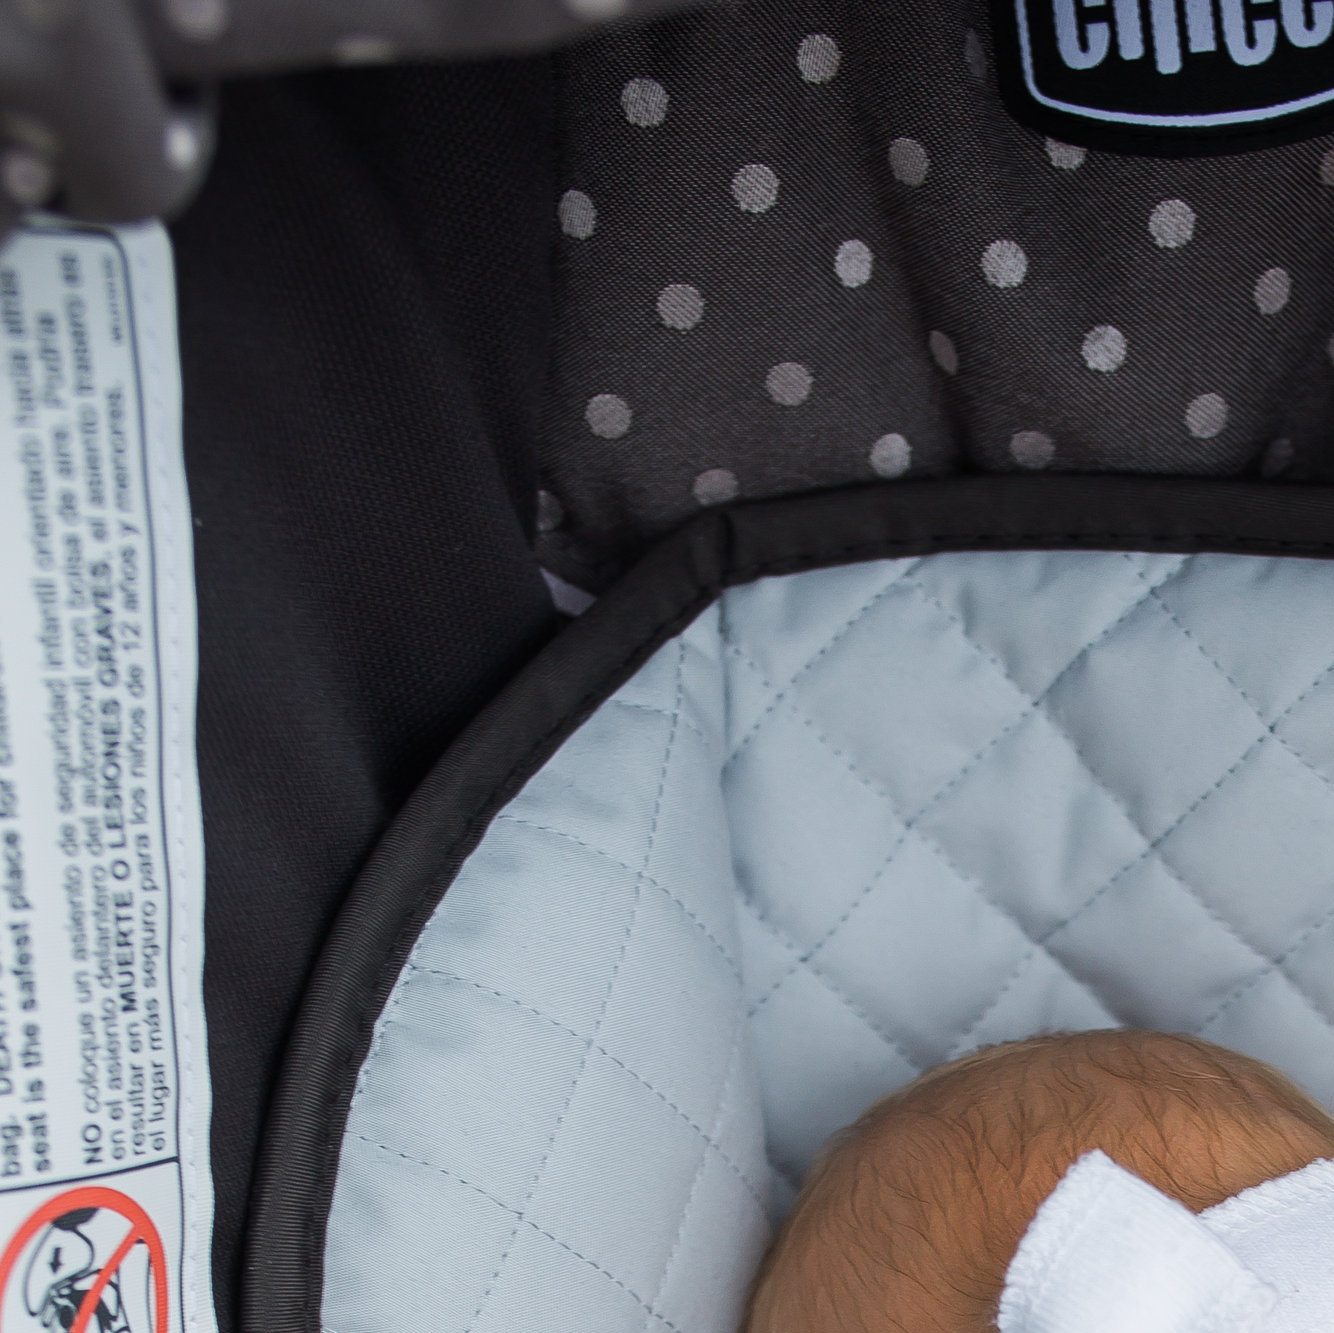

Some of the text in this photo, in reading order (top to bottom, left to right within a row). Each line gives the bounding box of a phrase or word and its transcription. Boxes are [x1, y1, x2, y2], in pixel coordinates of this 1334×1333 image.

[60, 254, 78, 286] es
[79, 407, 103, 508] asiento
[55, 492, 75, 525] de
[89, 518, 106, 543] el
[118, 520, 141, 537] y
[118, 547, 136, 612] años
[31, 580, 62, 668] infantil
[72, 619, 92, 667] con
[122, 624, 139, 651] 12
[126, 666, 143, 697] de
[44, 680, 76, 813] seguridad
[127, 709, 145, 777] niños
[101, 700, 125, 847] LESIONES
[130, 789, 147, 824] los
[59, 825, 78, 856] de
[81, 817, 102, 856] del
[5, 833, 32, 910] place
[111, 861, 129, 880] O
[134, 836, 157, 891] para
[64, 867, 86, 960] asiento
[91, 867, 114, 988] delantero
[10, 923, 36, 1009] safest
[114, 892, 138, 1012] MUERTE
[140, 903, 159, 987] seguro
[76, 972, 91, 1002] un
[19, 1024, 41, 1067] the
[101, 999, 121, 1090] asiento
[127, 1023, 142, 1052] en
[143, 1000, 163, 1050] más
[78, 1014, 104, 1112] coloque
[24, 1080, 43, 1101] is
[105, 1102, 122, 1119] el
[127, 1064, 146, 1155] resultar
[148, 1062, 169, 1122] lugar
[28, 1114, 50, 1171] seat
[83, 1125, 102, 1163] NO
[111, 1131, 125, 1159] en
[149, 1132, 165, 1150] el
